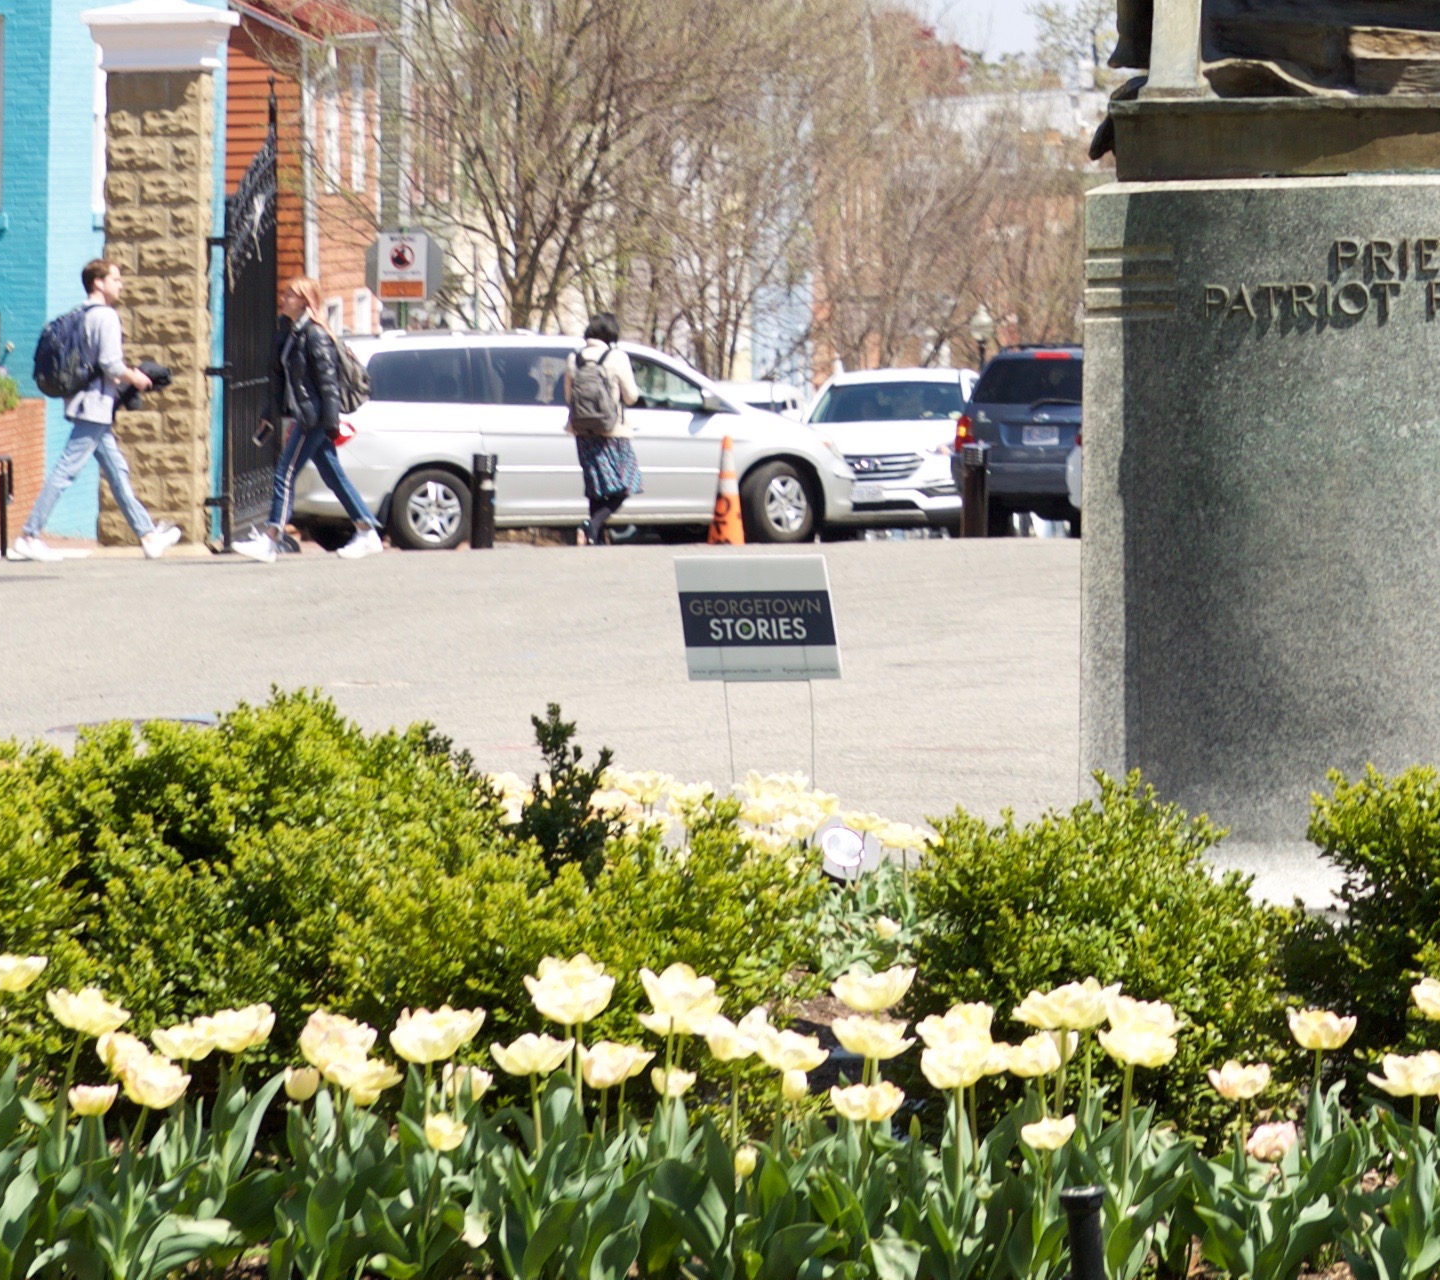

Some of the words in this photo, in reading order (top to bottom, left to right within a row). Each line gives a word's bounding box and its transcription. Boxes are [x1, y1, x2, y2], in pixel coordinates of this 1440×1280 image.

[1205, 281, 1401, 320] PATRIOT
[689, 598, 822, 616] GEORGETOWN
[710, 617, 808, 640] STORIES
